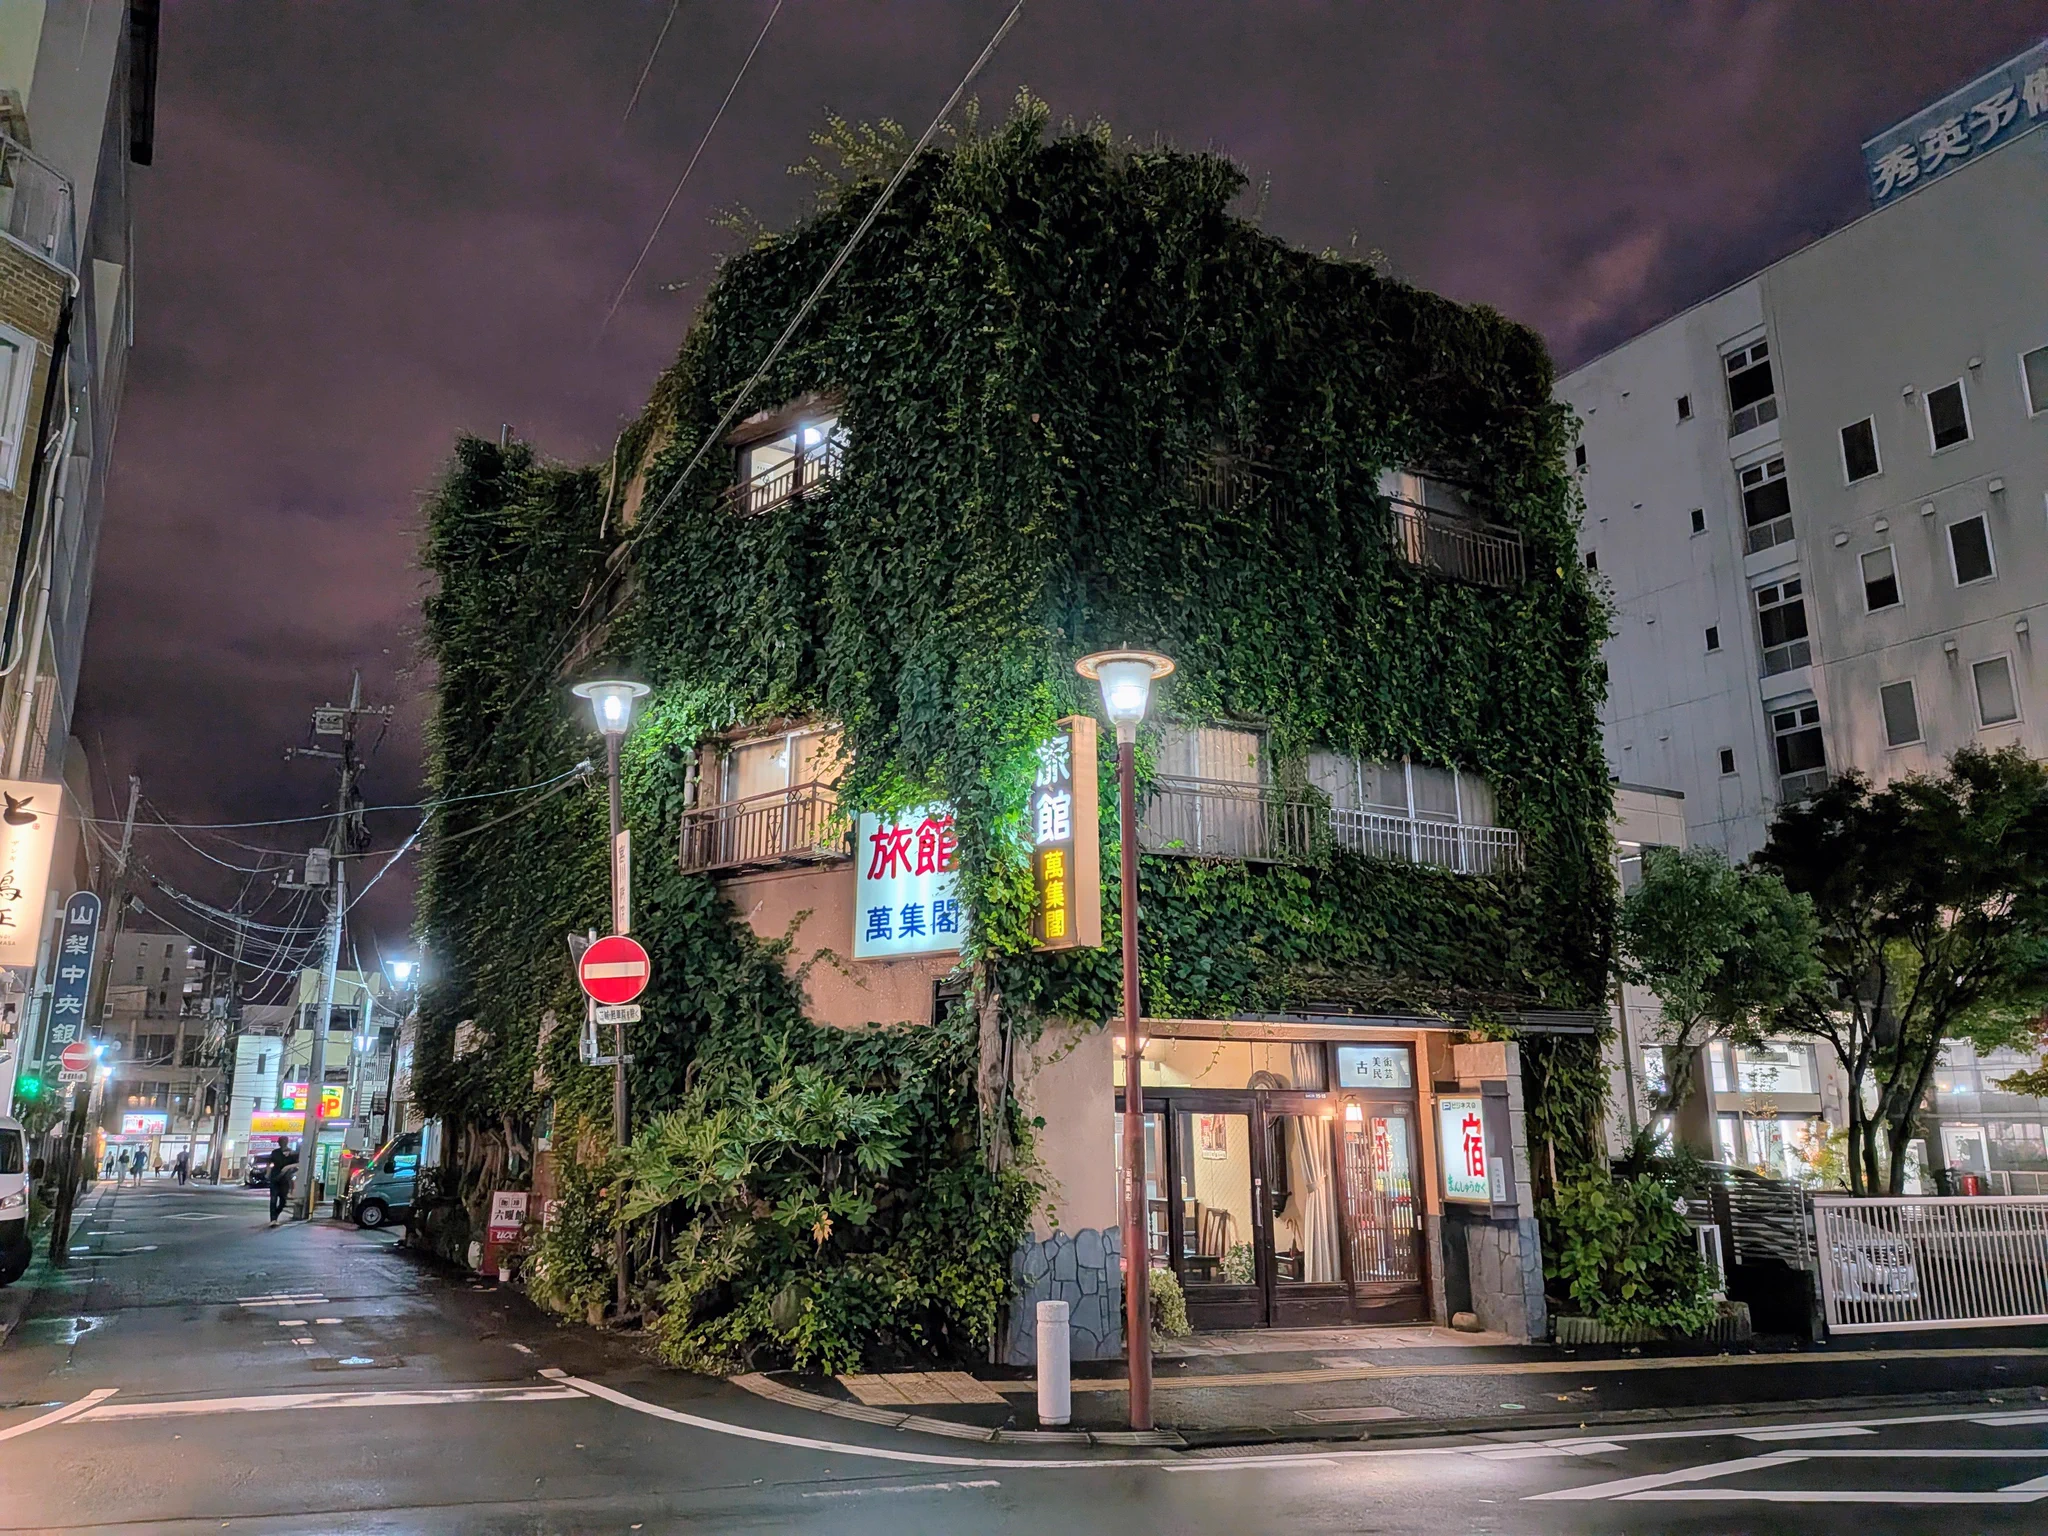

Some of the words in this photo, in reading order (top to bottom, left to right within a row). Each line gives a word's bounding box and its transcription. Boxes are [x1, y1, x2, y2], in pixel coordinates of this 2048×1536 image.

[1036, 735, 1071, 846] 旅館
[867, 815, 960, 880] 旅館
[1043, 850, 1065, 939] 萬集閣
[866, 898, 959, 943] 萬集閣
[1356, 1061, 1368, 1075] 古
[1373, 1057, 1392, 1067] 美術
[1373, 1068, 1393, 1079] 民芸
[326, 1098, 340, 1115] P
[1462, 1112, 1485, 1178] 宿
[1448, 1174, 1487, 1193] まんしゅうかく
